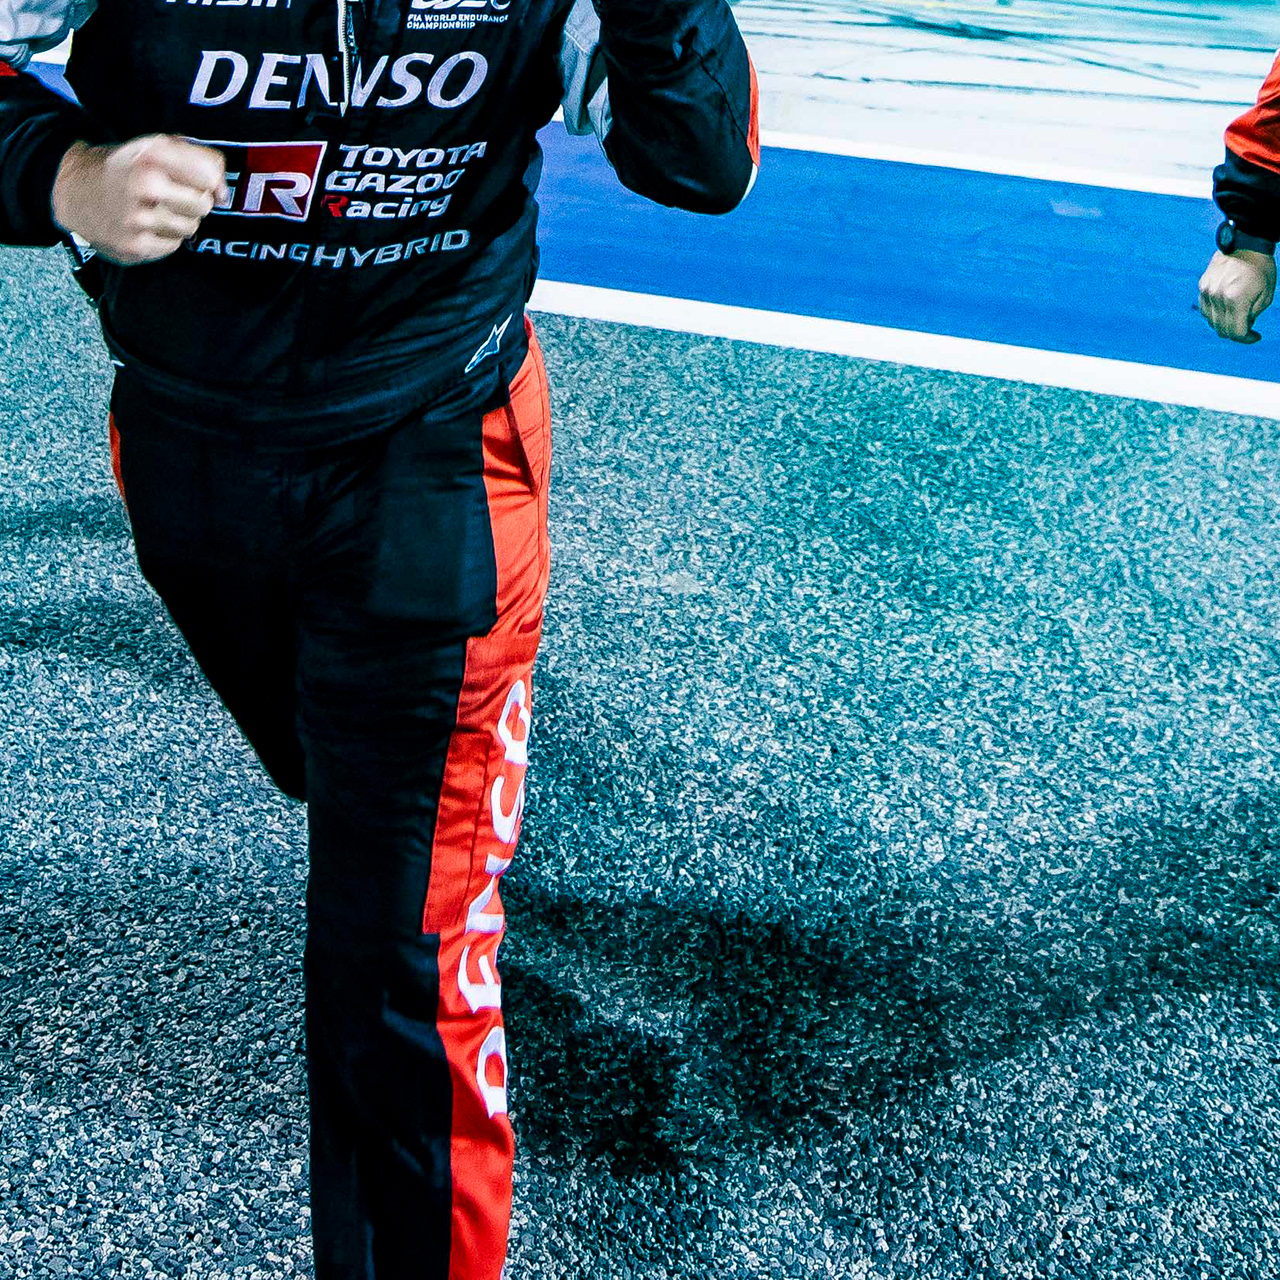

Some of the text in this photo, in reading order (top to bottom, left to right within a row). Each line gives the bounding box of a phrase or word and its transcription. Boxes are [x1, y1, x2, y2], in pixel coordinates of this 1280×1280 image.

[406, 21, 476, 30] CHAMPIONSHIP
[407, 13, 422, 22] FIA
[424, 13, 457, 22] WORLD
[189, 50, 488, 109] DENSO
[338, 141, 487, 169] TOYOTA
[324, 168, 466, 193] GAZOO
[320, 193, 452, 218] Racing
[188, 234, 310, 263] ACING
